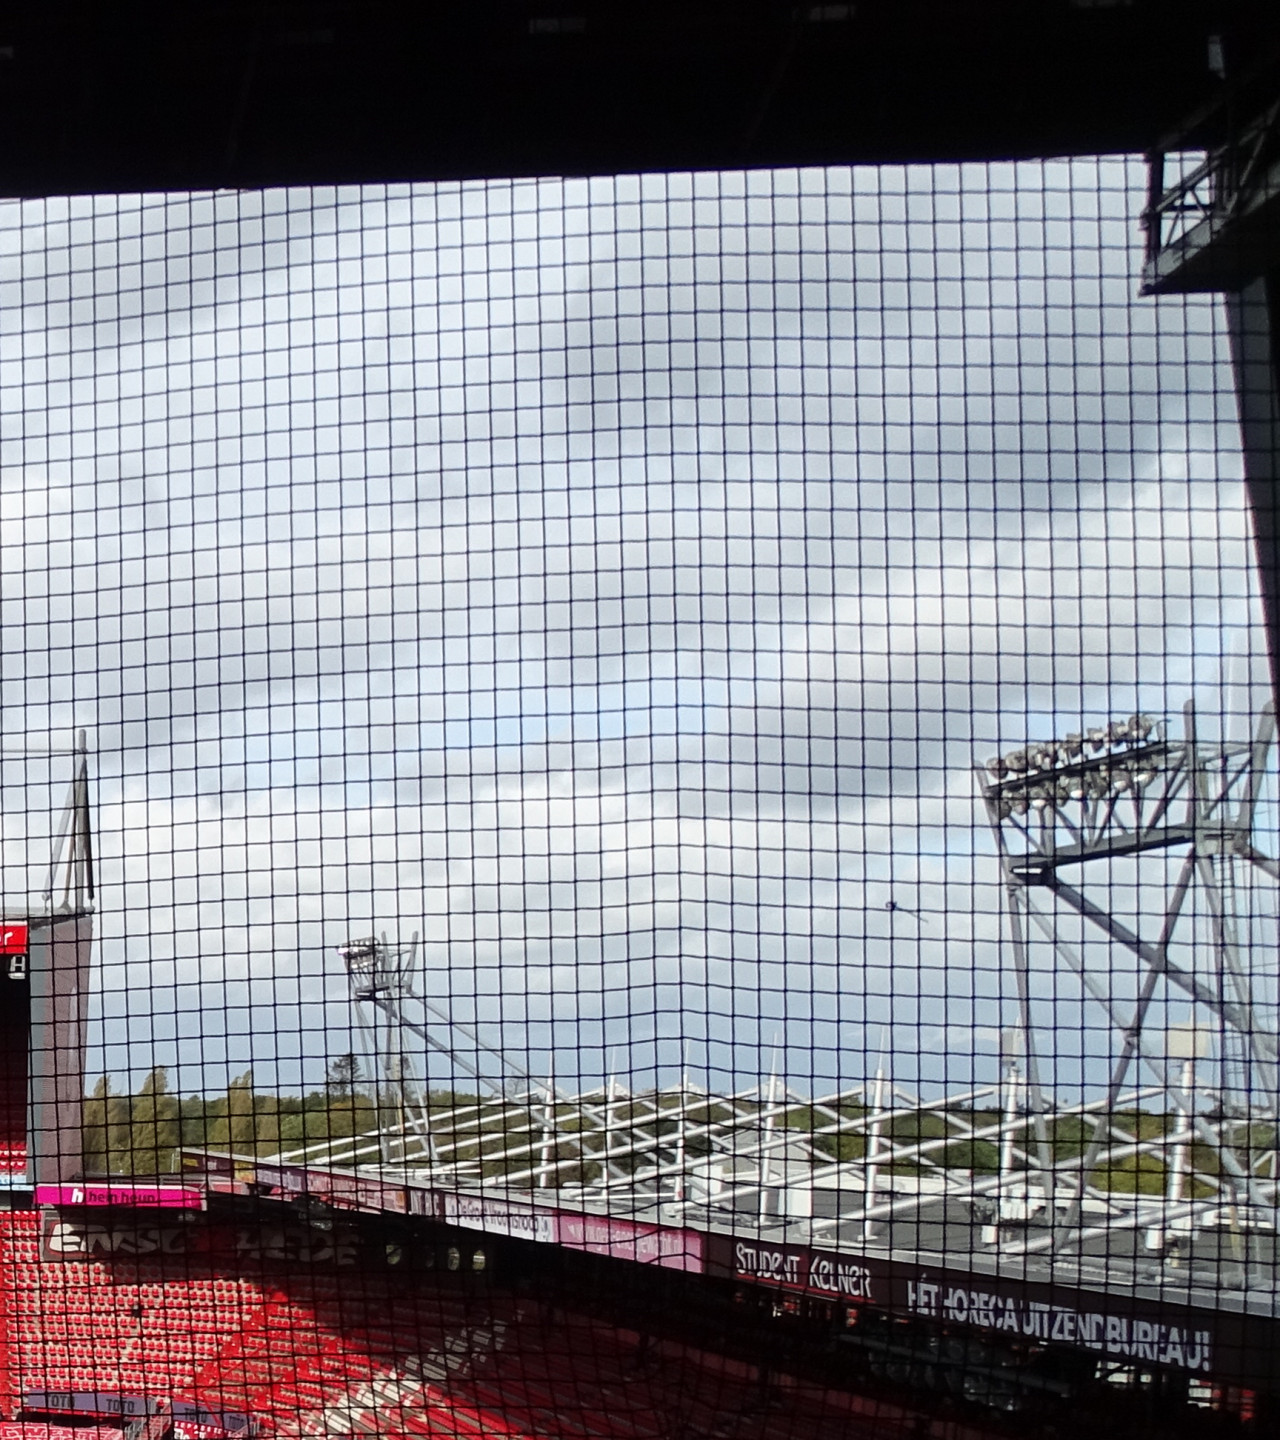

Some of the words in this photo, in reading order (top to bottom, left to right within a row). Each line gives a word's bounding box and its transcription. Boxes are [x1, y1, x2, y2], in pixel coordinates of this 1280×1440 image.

[943, 1287, 1019, 1333] HORECA
[1021, 1300, 1211, 1372] UITZENDBUREAU!
[48, 1394, 76, 1409] TOTO
[106, 1398, 135, 1414] TOTO
